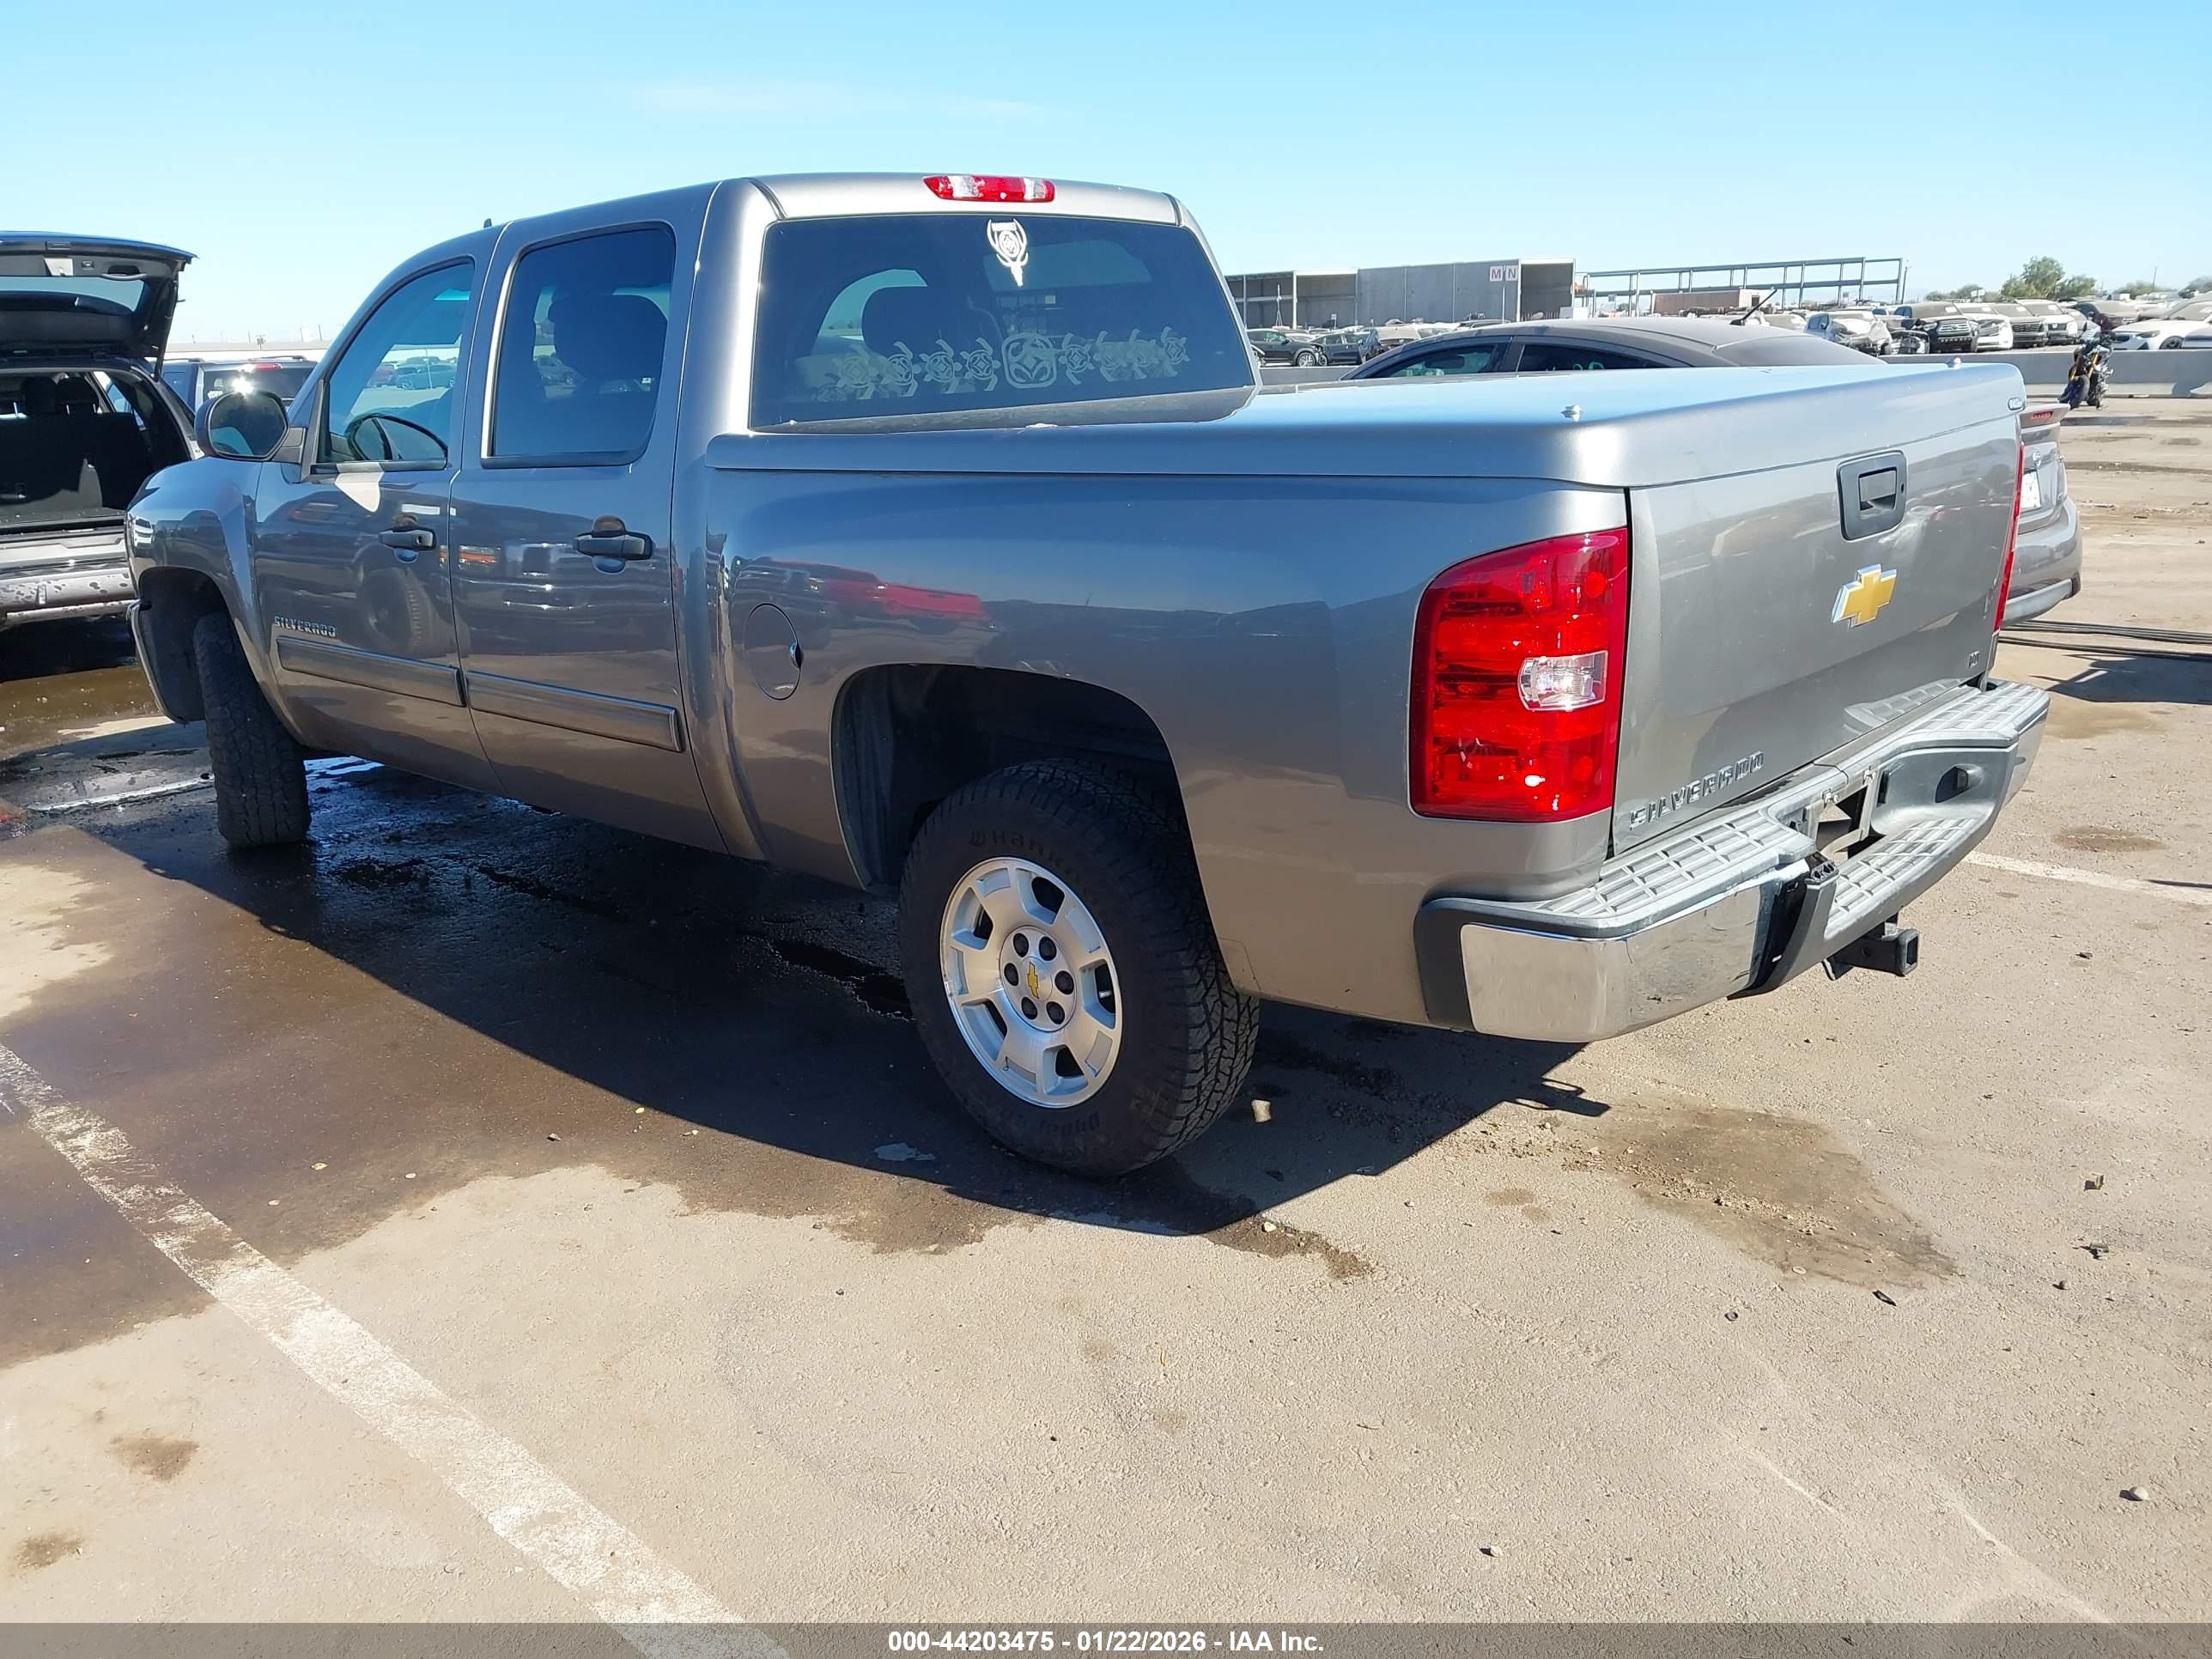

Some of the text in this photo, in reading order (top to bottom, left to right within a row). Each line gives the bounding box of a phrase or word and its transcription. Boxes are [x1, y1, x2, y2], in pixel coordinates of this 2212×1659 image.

[1491, 267, 1517, 280] M N
[274, 616, 336, 637] SILVERADO
[1630, 750, 1765, 830] SILVERADO
